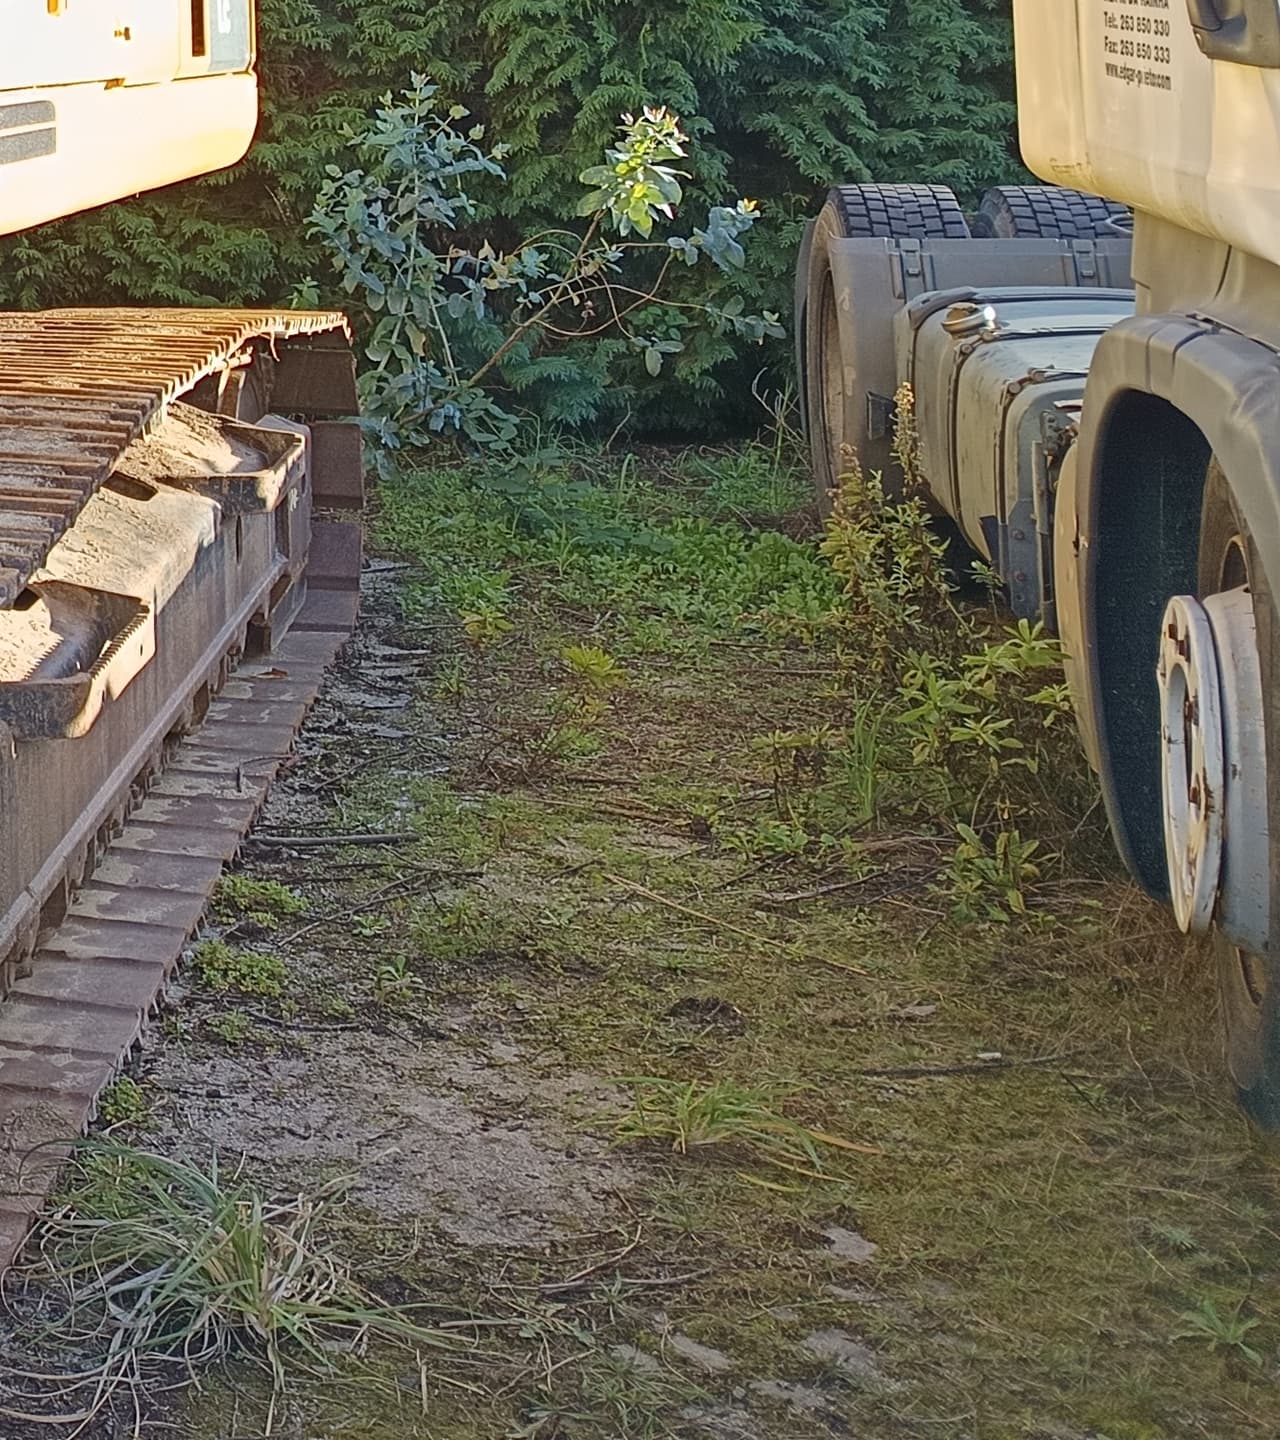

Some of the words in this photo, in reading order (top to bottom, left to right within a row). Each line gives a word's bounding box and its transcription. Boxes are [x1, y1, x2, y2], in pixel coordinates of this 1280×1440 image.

[1120, 14, 1134, 31] 263
[1136, 16, 1151, 34] 850
[1153, 19, 1170, 37] 330
[1120, 39, 1134, 57] 263
[1136, 41, 1151, 60] 850
[1154, 45, 1171, 64] 333
